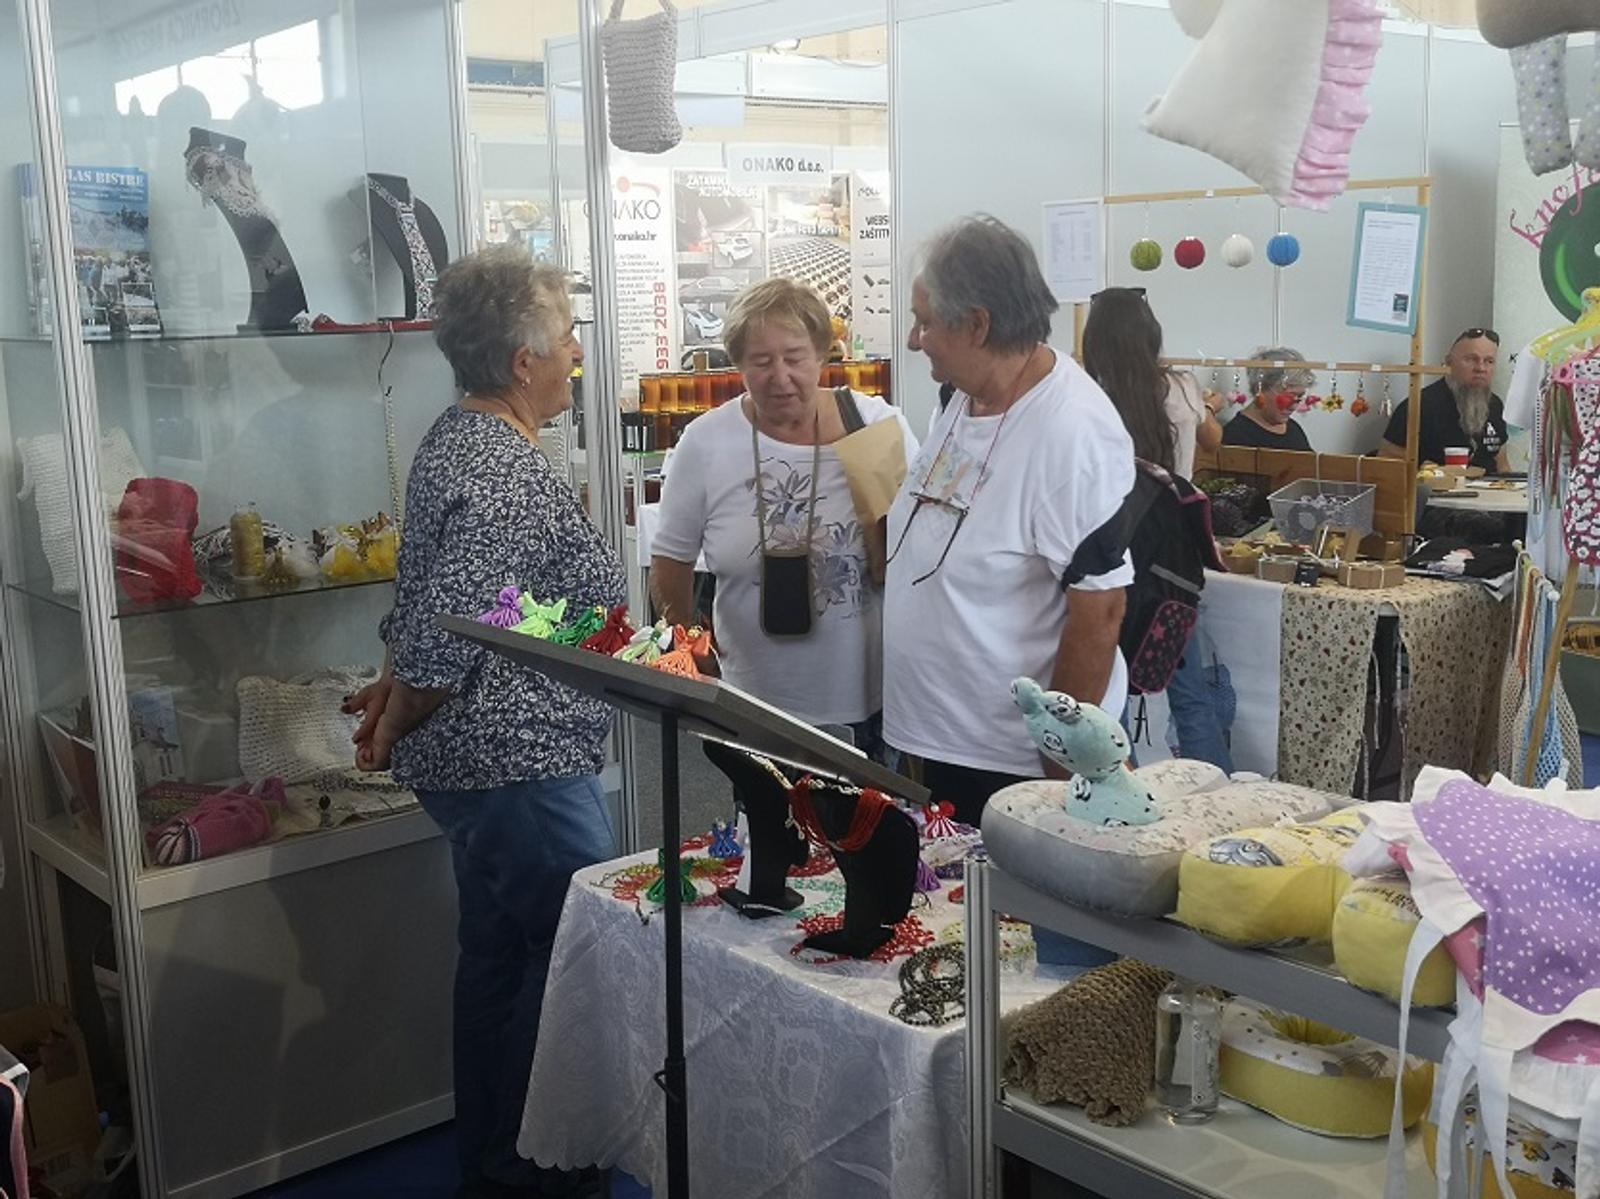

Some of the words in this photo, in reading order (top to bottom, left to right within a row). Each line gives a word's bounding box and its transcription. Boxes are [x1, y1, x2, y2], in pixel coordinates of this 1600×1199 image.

[742, 156, 795, 173] ONAKO
[652, 281, 668, 330] 2038
[655, 335, 670, 370] 933
